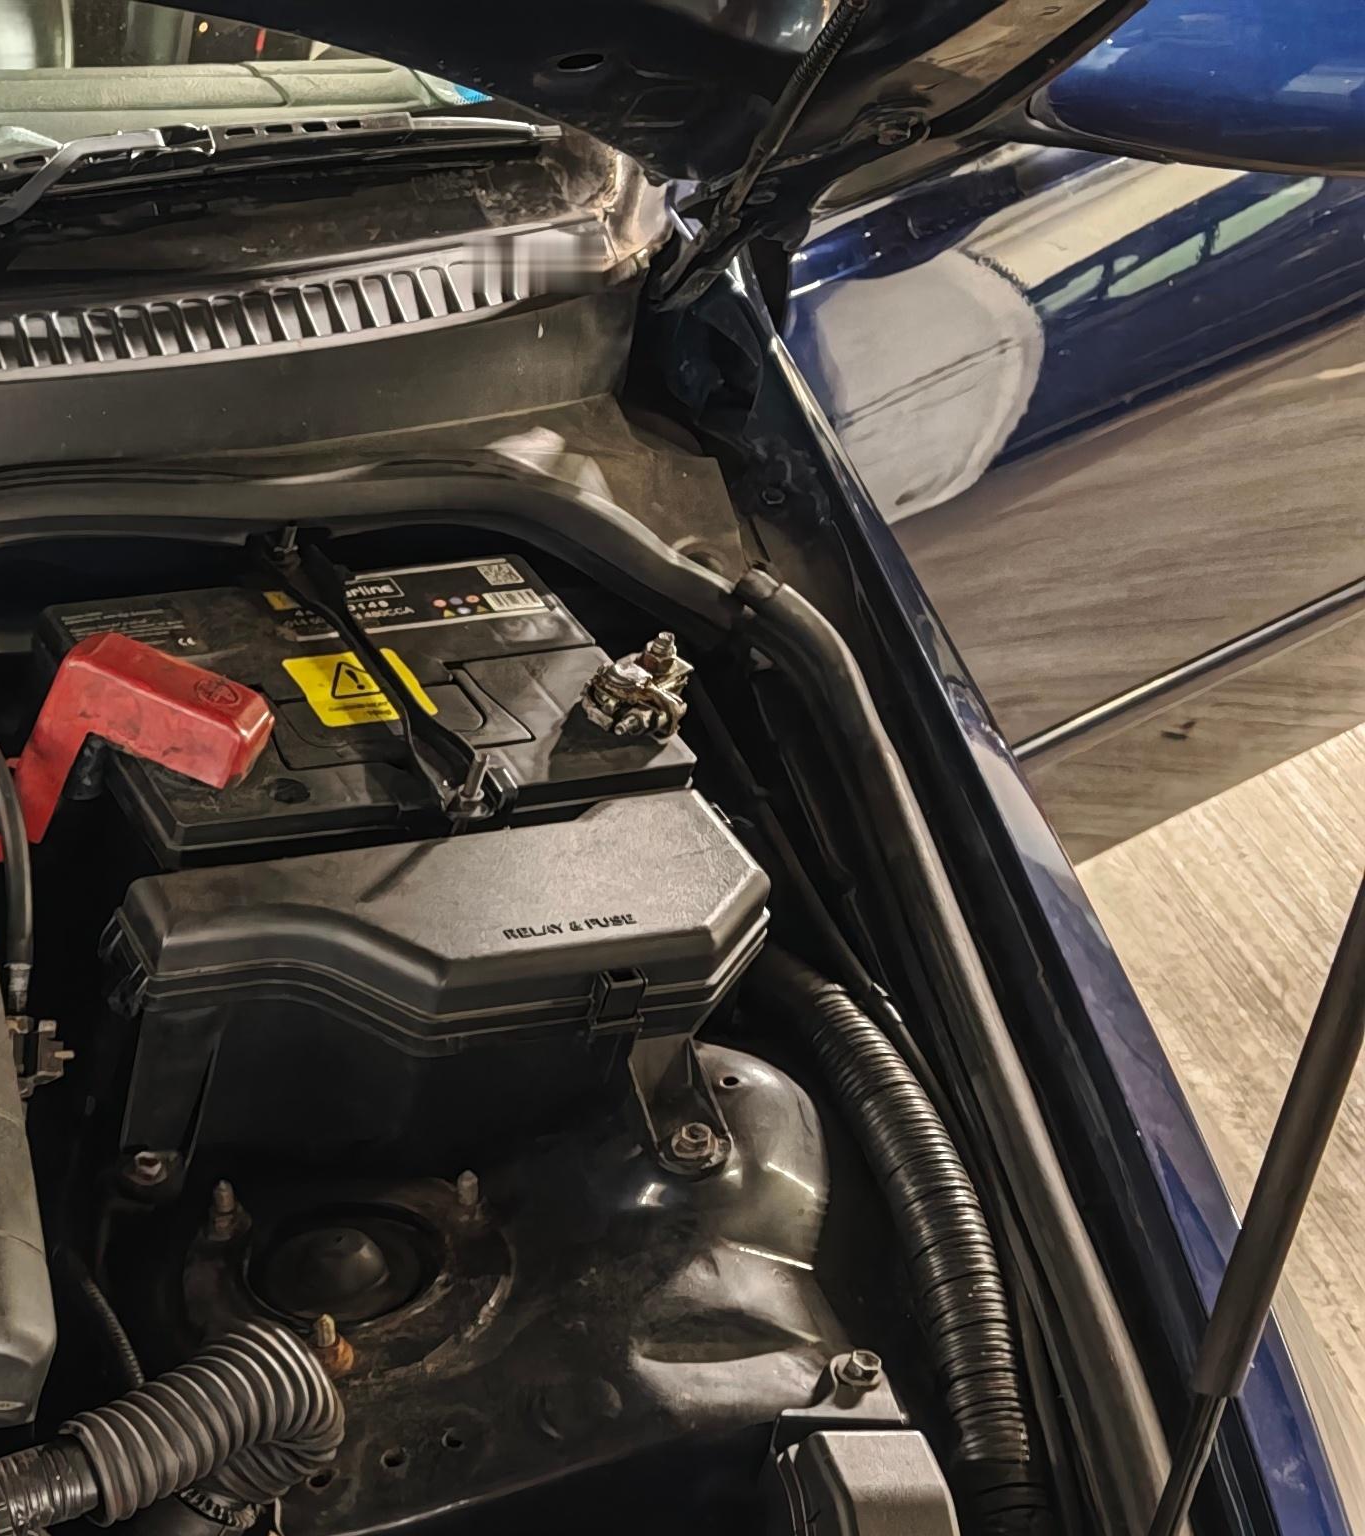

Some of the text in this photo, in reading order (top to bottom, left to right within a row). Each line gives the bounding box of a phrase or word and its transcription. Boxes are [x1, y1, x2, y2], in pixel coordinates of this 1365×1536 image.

[502, 913, 638, 940] RELAY & FUSE
